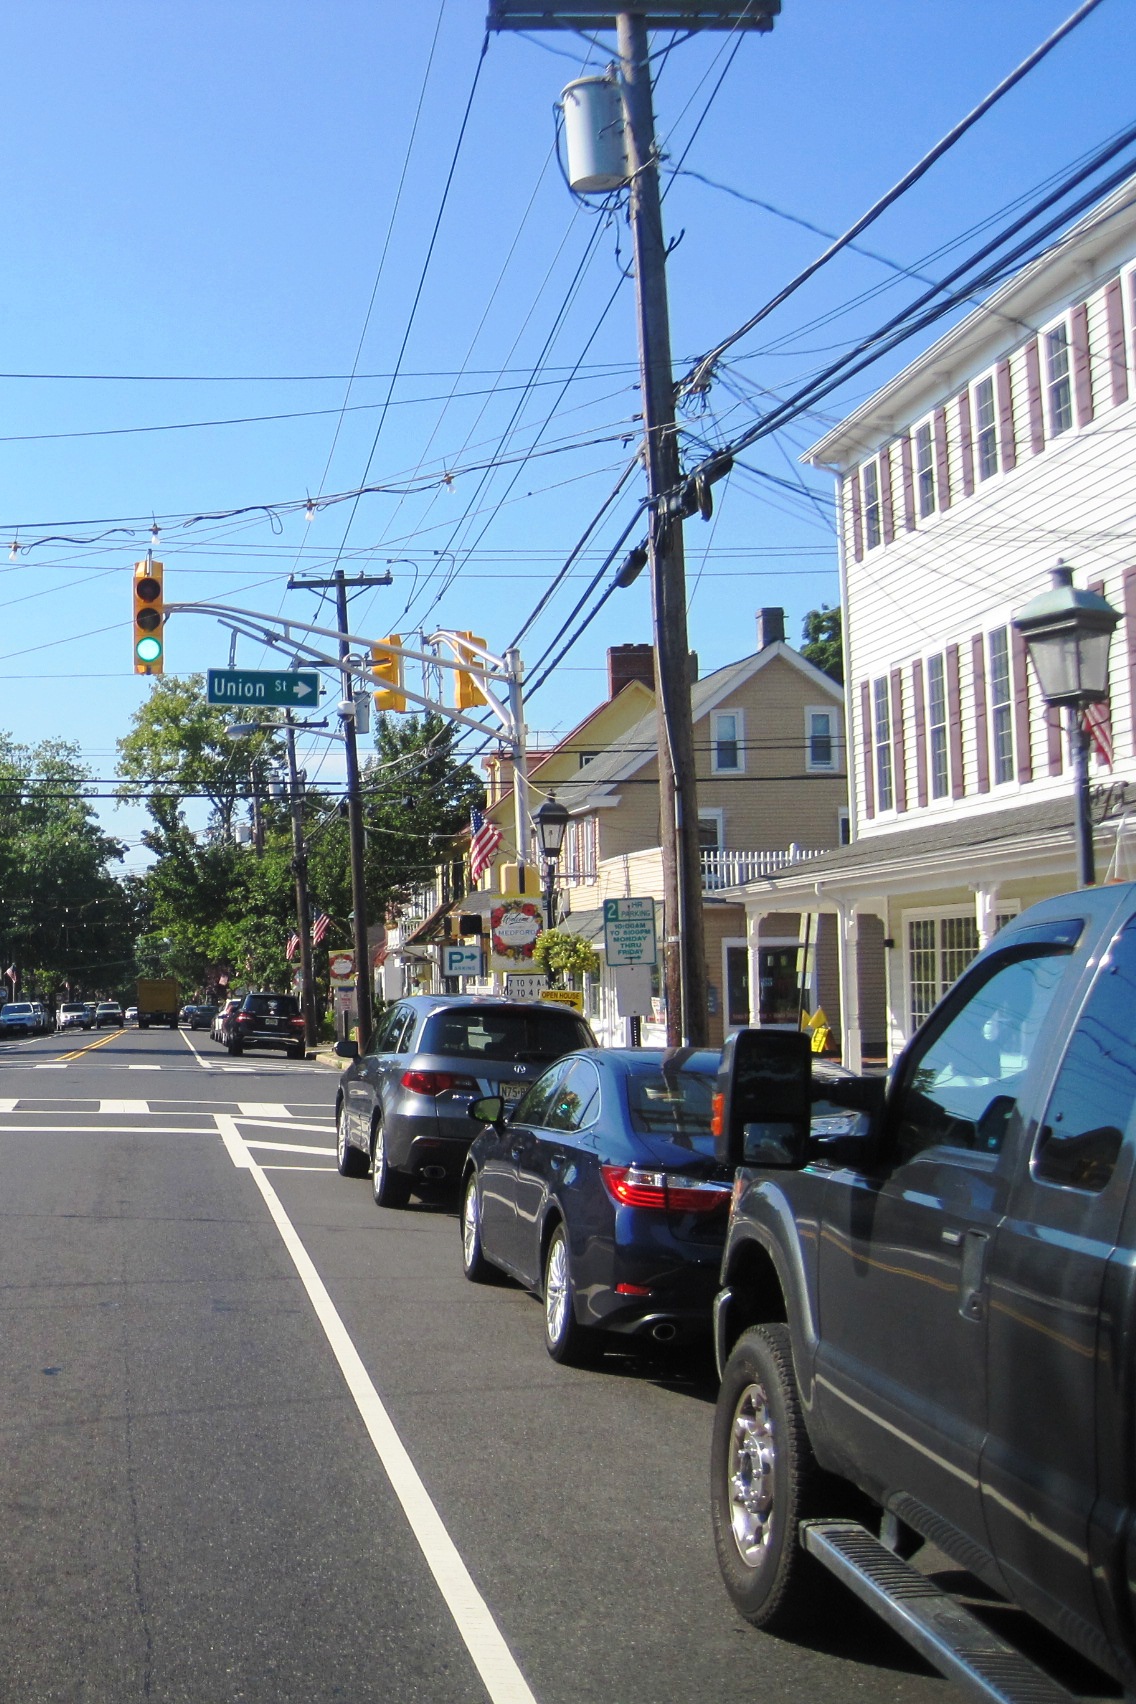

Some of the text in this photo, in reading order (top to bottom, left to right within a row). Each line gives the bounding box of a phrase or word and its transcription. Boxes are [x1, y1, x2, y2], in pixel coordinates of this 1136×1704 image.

[214, 678, 287, 697] Union St
[607, 902, 616, 918] 2
